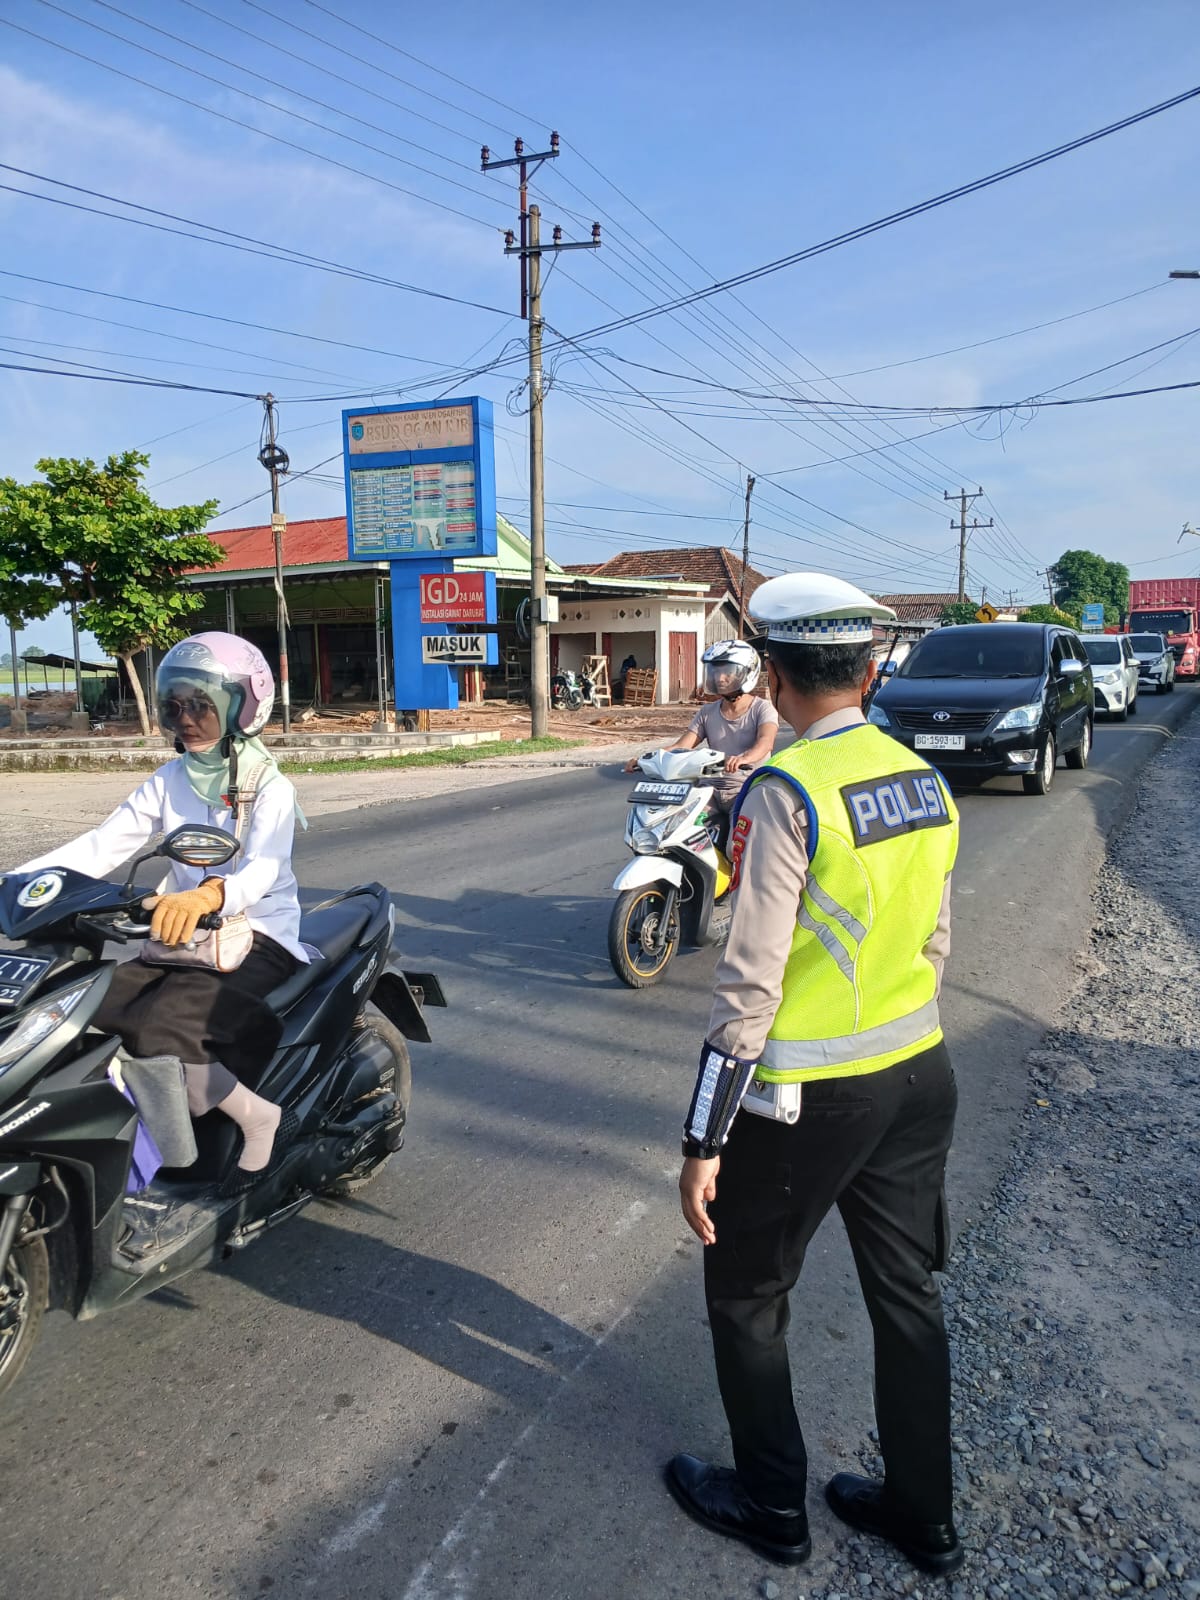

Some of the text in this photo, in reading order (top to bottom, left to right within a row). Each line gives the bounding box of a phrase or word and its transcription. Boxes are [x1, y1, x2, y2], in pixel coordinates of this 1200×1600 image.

[367, 424, 399, 441] RSUD
[421, 577, 460, 604] IGD
[459, 591, 483, 603] 24 JAM
[427, 636, 480, 652] MASUK
[952, 736, 962, 745] LT
[849, 777, 947, 836] POLISI
[10, 962, 41, 981] TY
[0, 988, 21, 998] 27
[0, 1101, 52, 1137] HONDA
